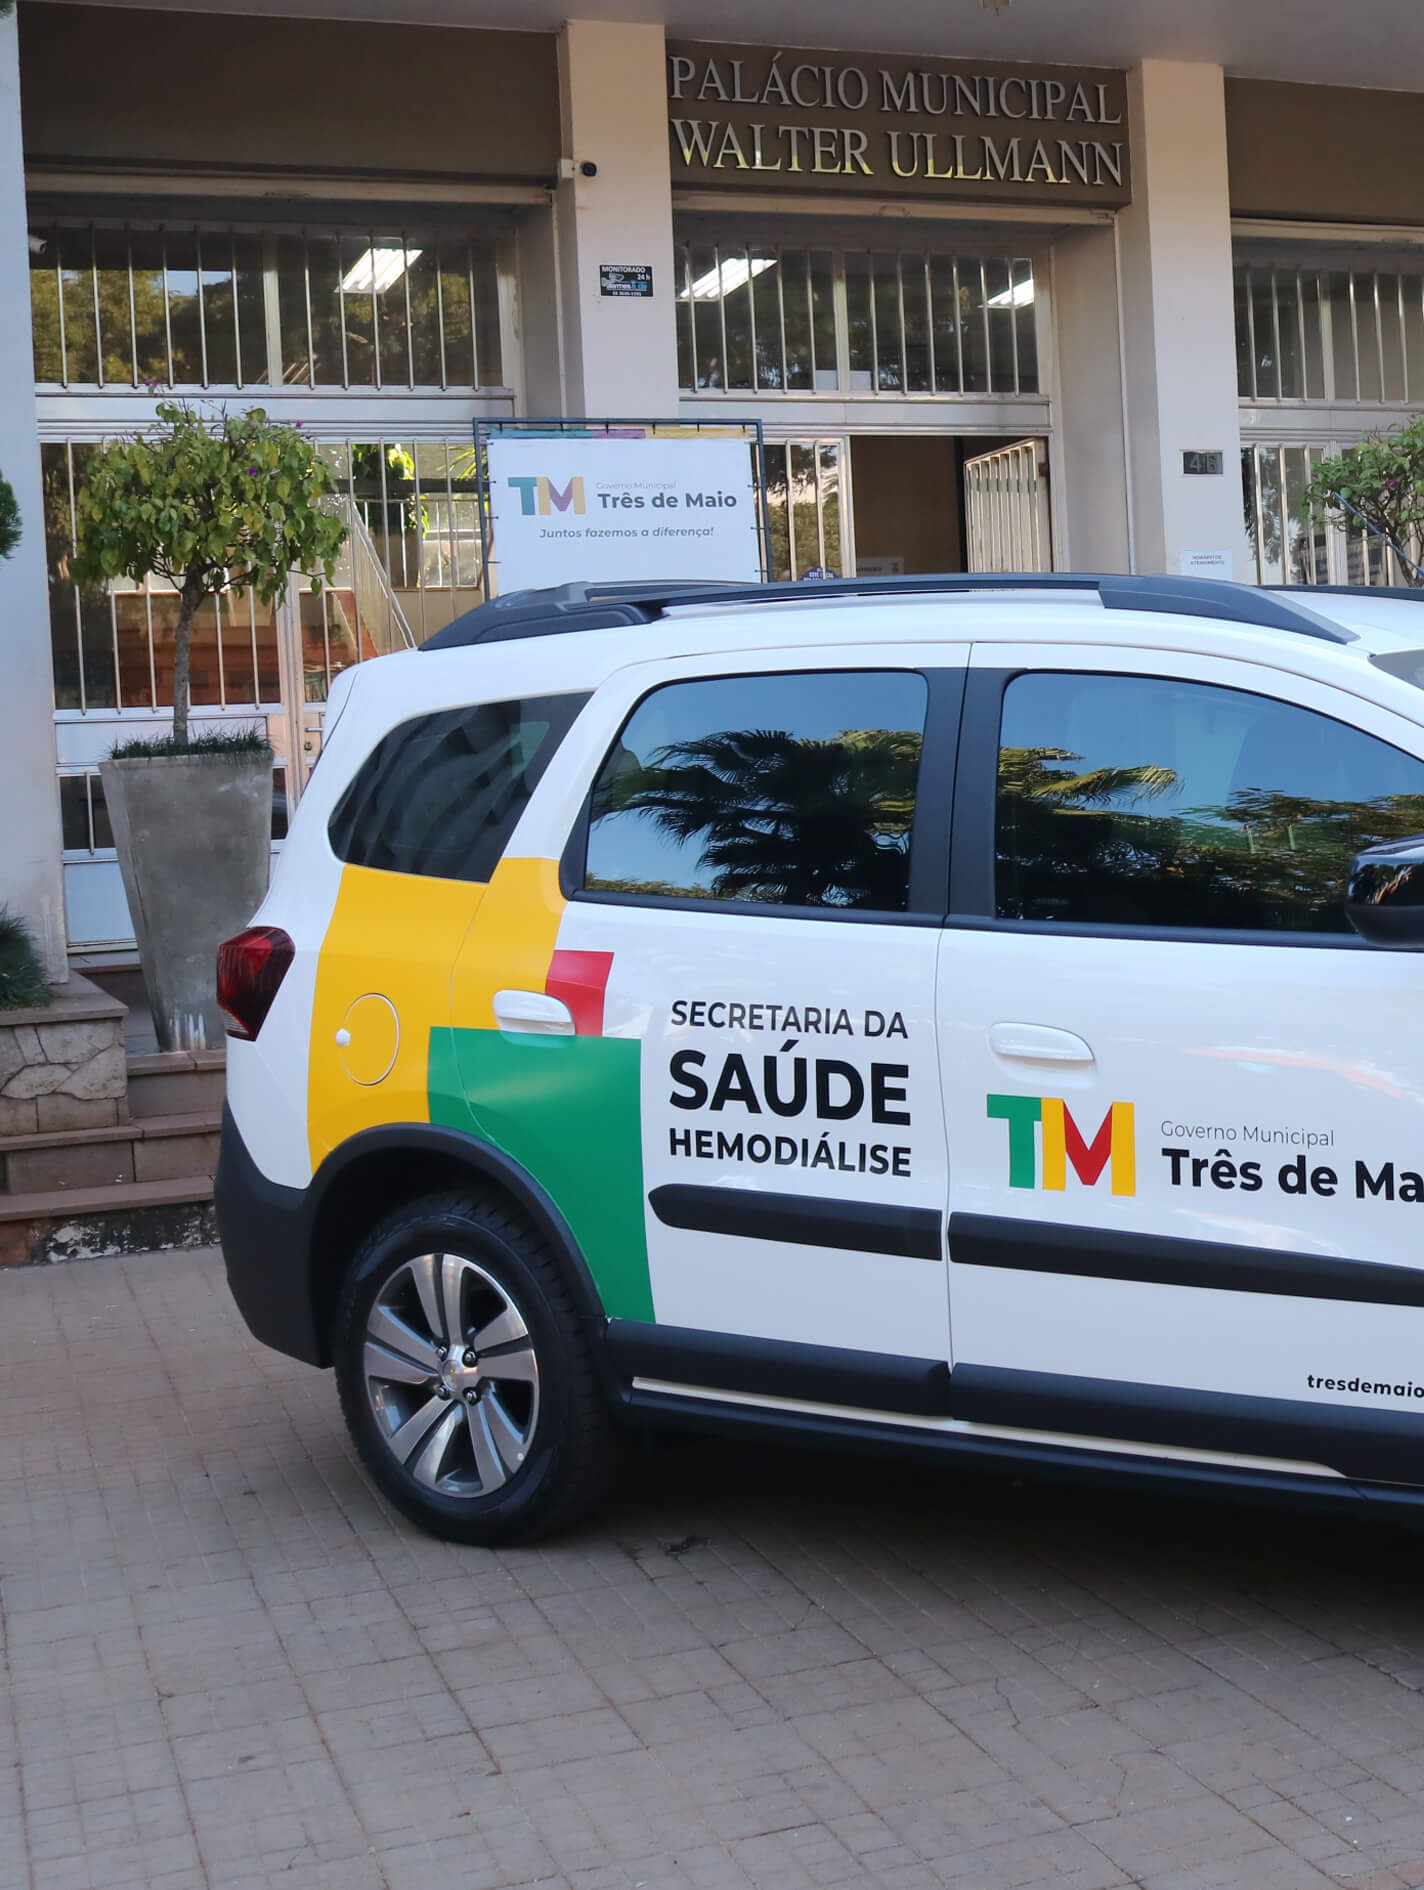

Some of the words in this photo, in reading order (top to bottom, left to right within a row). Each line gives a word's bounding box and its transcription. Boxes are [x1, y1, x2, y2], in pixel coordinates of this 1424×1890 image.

[669, 50, 869, 111] PALÁCIO
[879, 68, 1123, 125] MUNICIPAL
[671, 117, 875, 176] WALTER
[887, 129, 1124, 187] ULLMANN
[507, 476, 586, 516] TM
[597, 492, 645, 509] Três
[651, 491, 679, 509] de
[685, 490, 737, 508] Maio
[539, 528, 583, 538] Juntos
[585, 527, 638, 538] fazemos
[641, 529, 650, 537] a
[652, 526, 714, 538] diferença!
[671, 1000, 855, 1035] SECRETARIA
[864, 1010, 908, 1038] DA
[669, 1039, 911, 1126] SAÚDE
[669, 1127, 912, 1177] HEMODIÁLISE
[986, 1093, 1136, 1196] TM
[1160, 1120, 1237, 1141] Governo
[1243, 1125, 1335, 1150] Municipal
[1161, 1147, 1263, 1191] Três
[1278, 1154, 1338, 1197] de
